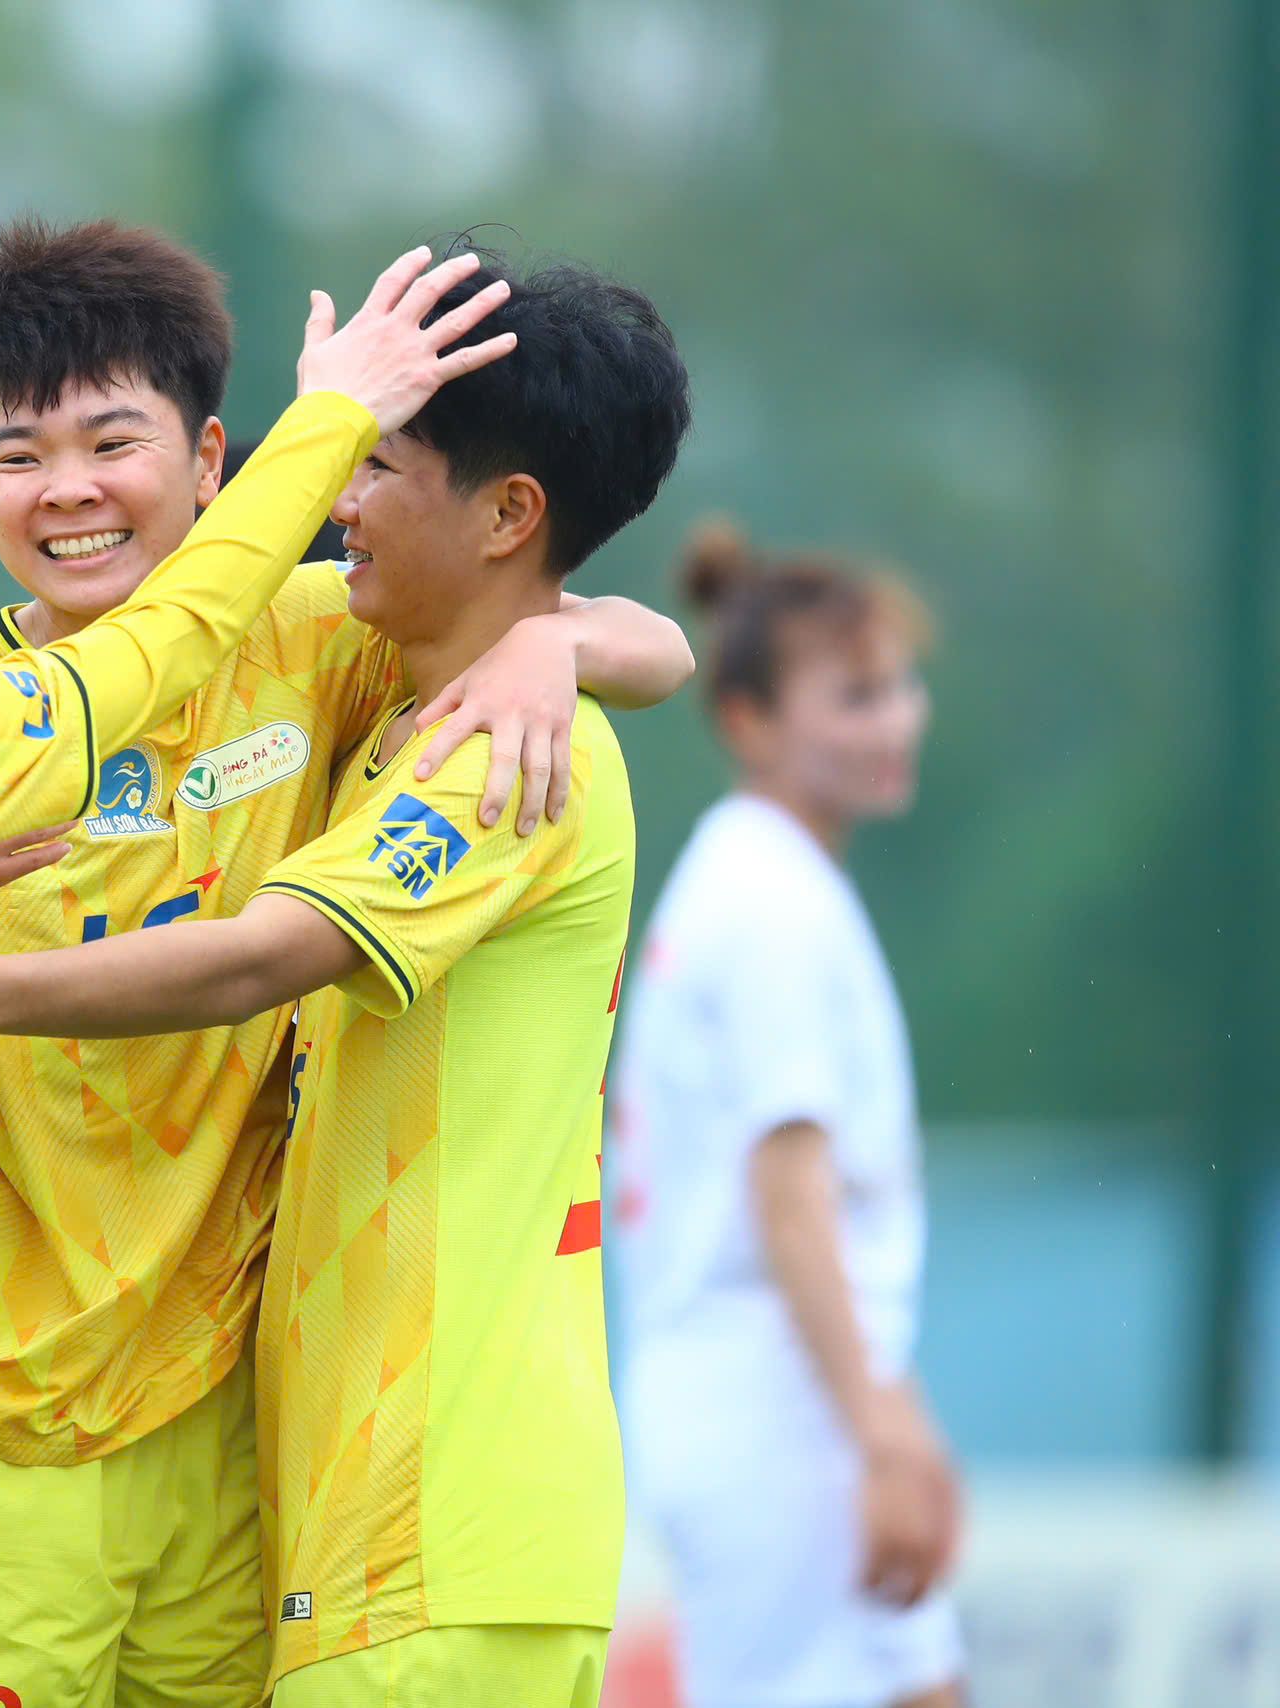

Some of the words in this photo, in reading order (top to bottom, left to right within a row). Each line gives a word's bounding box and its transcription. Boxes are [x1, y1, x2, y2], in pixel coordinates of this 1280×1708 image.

[270, 751, 294, 770] MAI
[87, 814, 115, 834] THÁI
[113, 813, 141, 833] SƠN
[139, 814, 170, 832] BẮC
[368, 833, 434, 900] TSN
